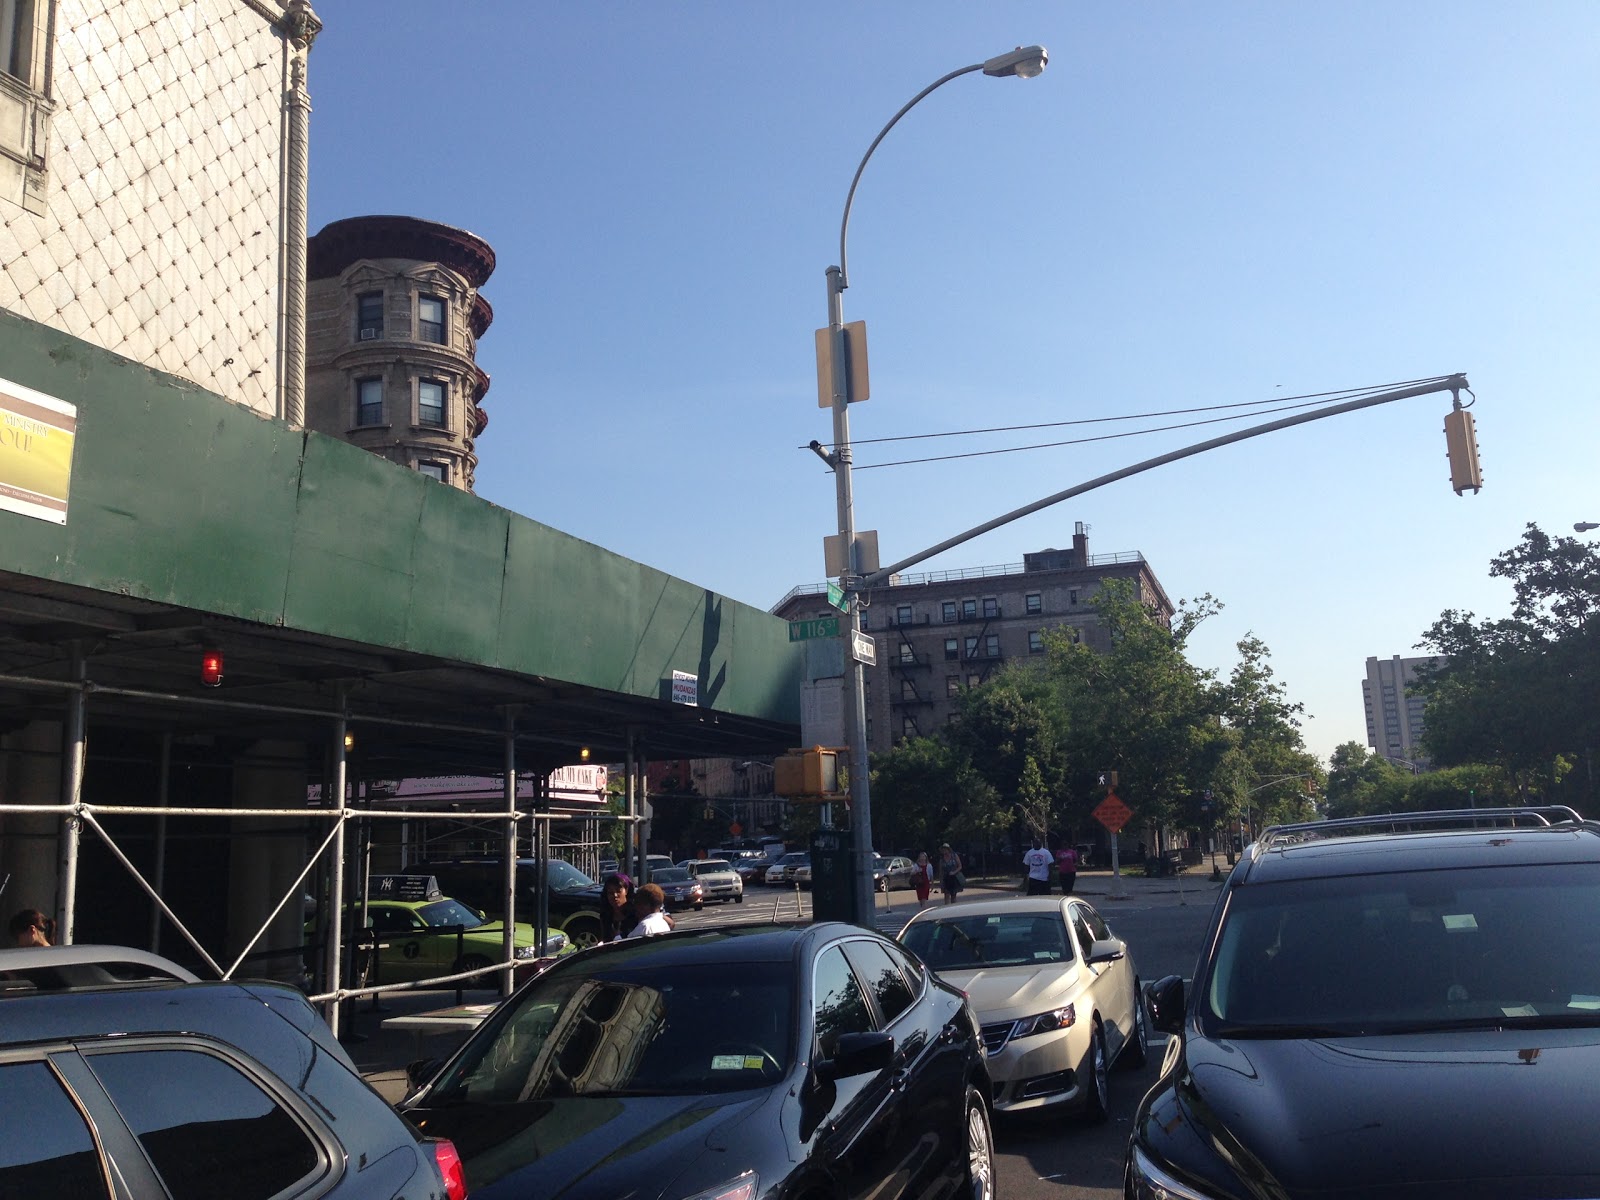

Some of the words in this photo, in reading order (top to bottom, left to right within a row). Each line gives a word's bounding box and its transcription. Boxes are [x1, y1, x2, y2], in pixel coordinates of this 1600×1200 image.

[4, 414, 48, 437] MINISTRY
[791, 624, 801, 639] W
[807, 622, 826, 637] 116
[827, 619, 837, 628] ST
[567, 767, 575, 782] MY
[577, 769, 593, 784] CAKE
